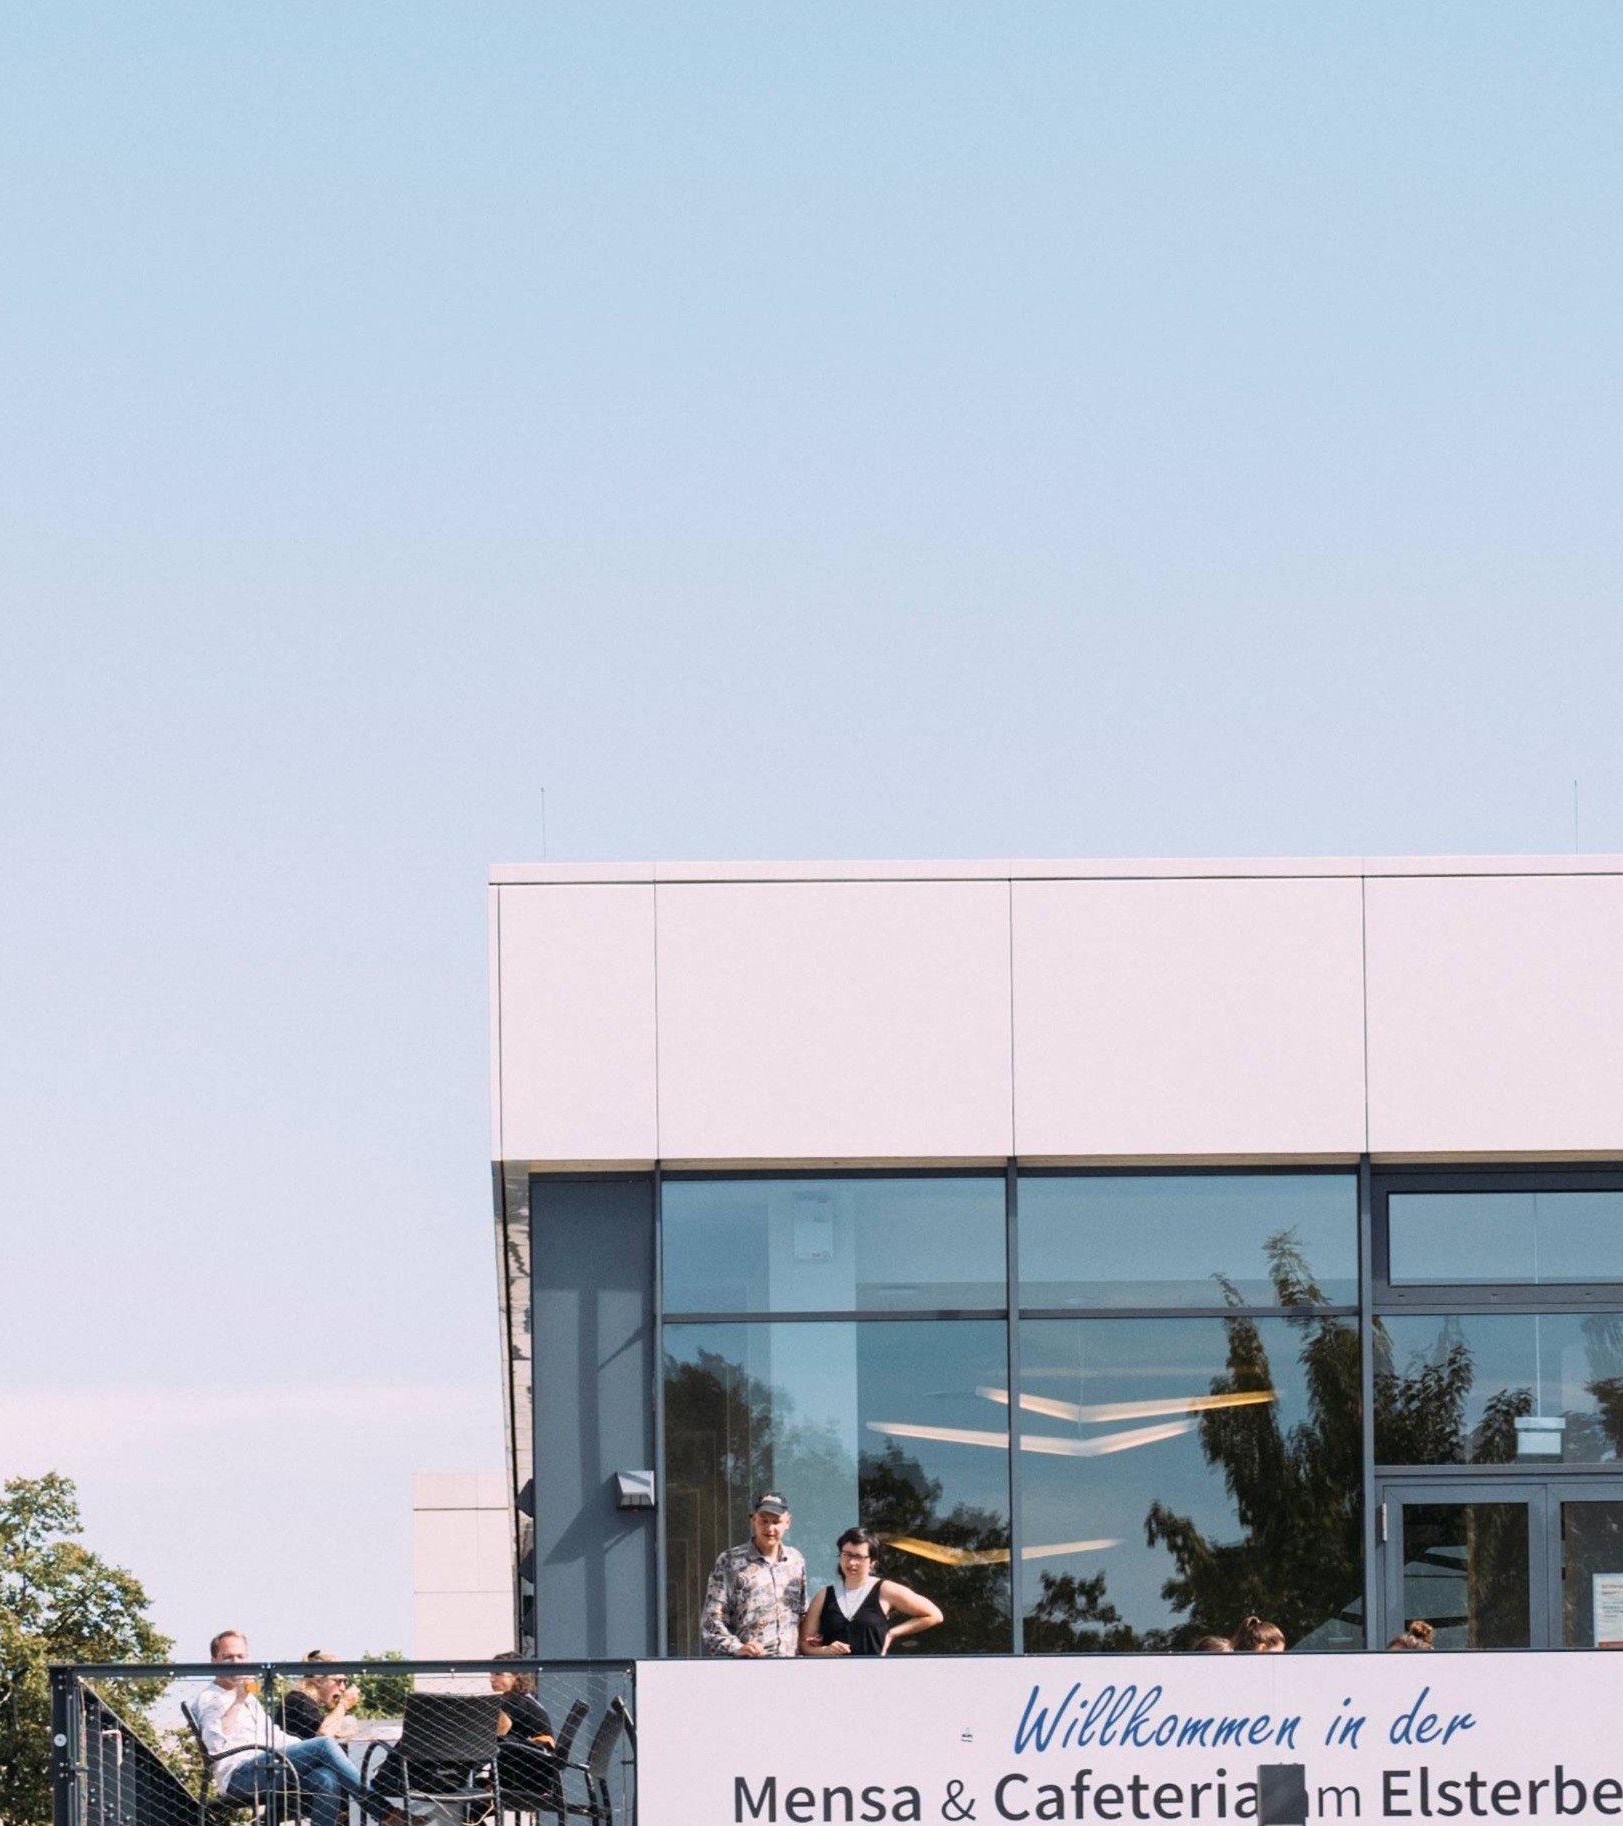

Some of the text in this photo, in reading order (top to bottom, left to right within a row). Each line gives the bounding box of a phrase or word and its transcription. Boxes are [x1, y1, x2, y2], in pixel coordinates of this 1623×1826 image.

[1014, 1682, 1477, 1755] Willkommen in der
[734, 1776, 922, 1824] Mensa
[941, 1779, 977, 1822] &
[994, 1767, 1259, 1822] Cafeteria
[1304, 1785, 1361, 1818] m
